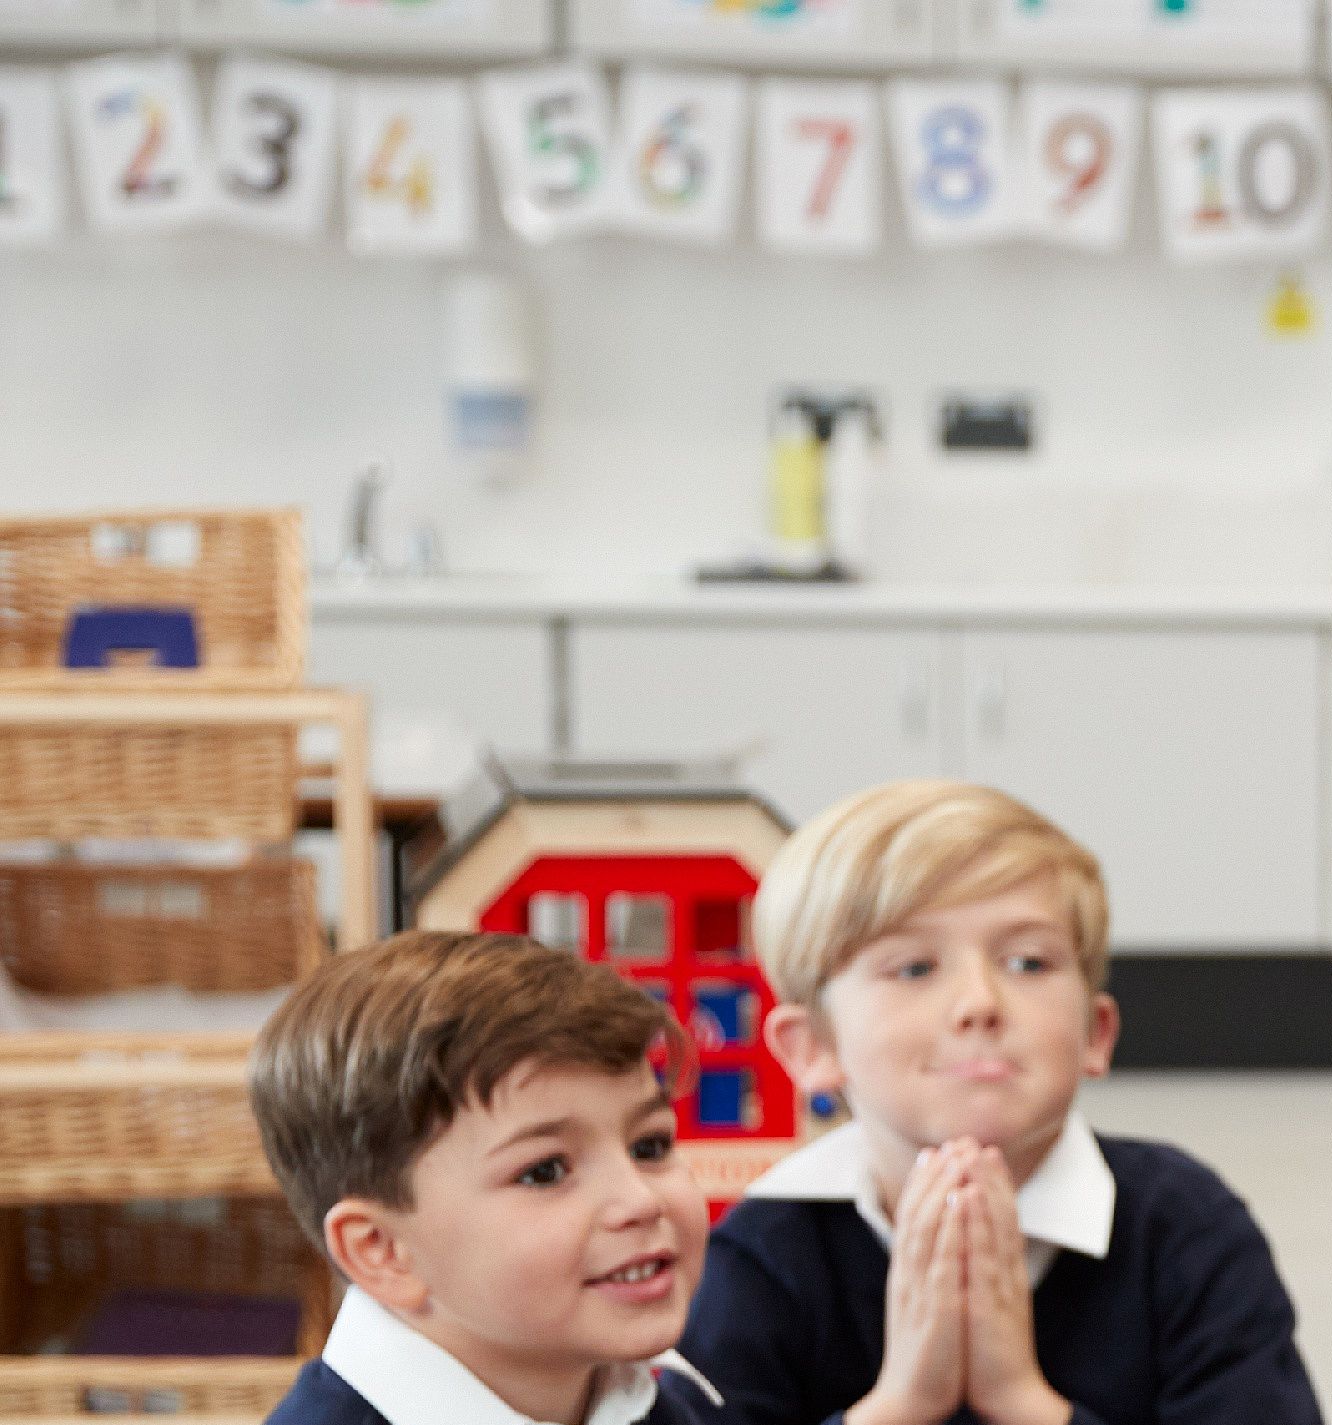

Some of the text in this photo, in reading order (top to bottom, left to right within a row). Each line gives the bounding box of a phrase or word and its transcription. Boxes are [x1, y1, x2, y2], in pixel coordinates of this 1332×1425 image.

[96, 89, 182, 200] 2
[218, 91, 304, 201] 3
[358, 114, 434, 216] 4
[523, 93, 601, 209] 5
[636, 103, 709, 212] 6
[790, 116, 858, 220] 7
[912, 104, 993, 216] 8
[1043, 112, 1114, 214] 9
[1187, 119, 1319, 232] 10
